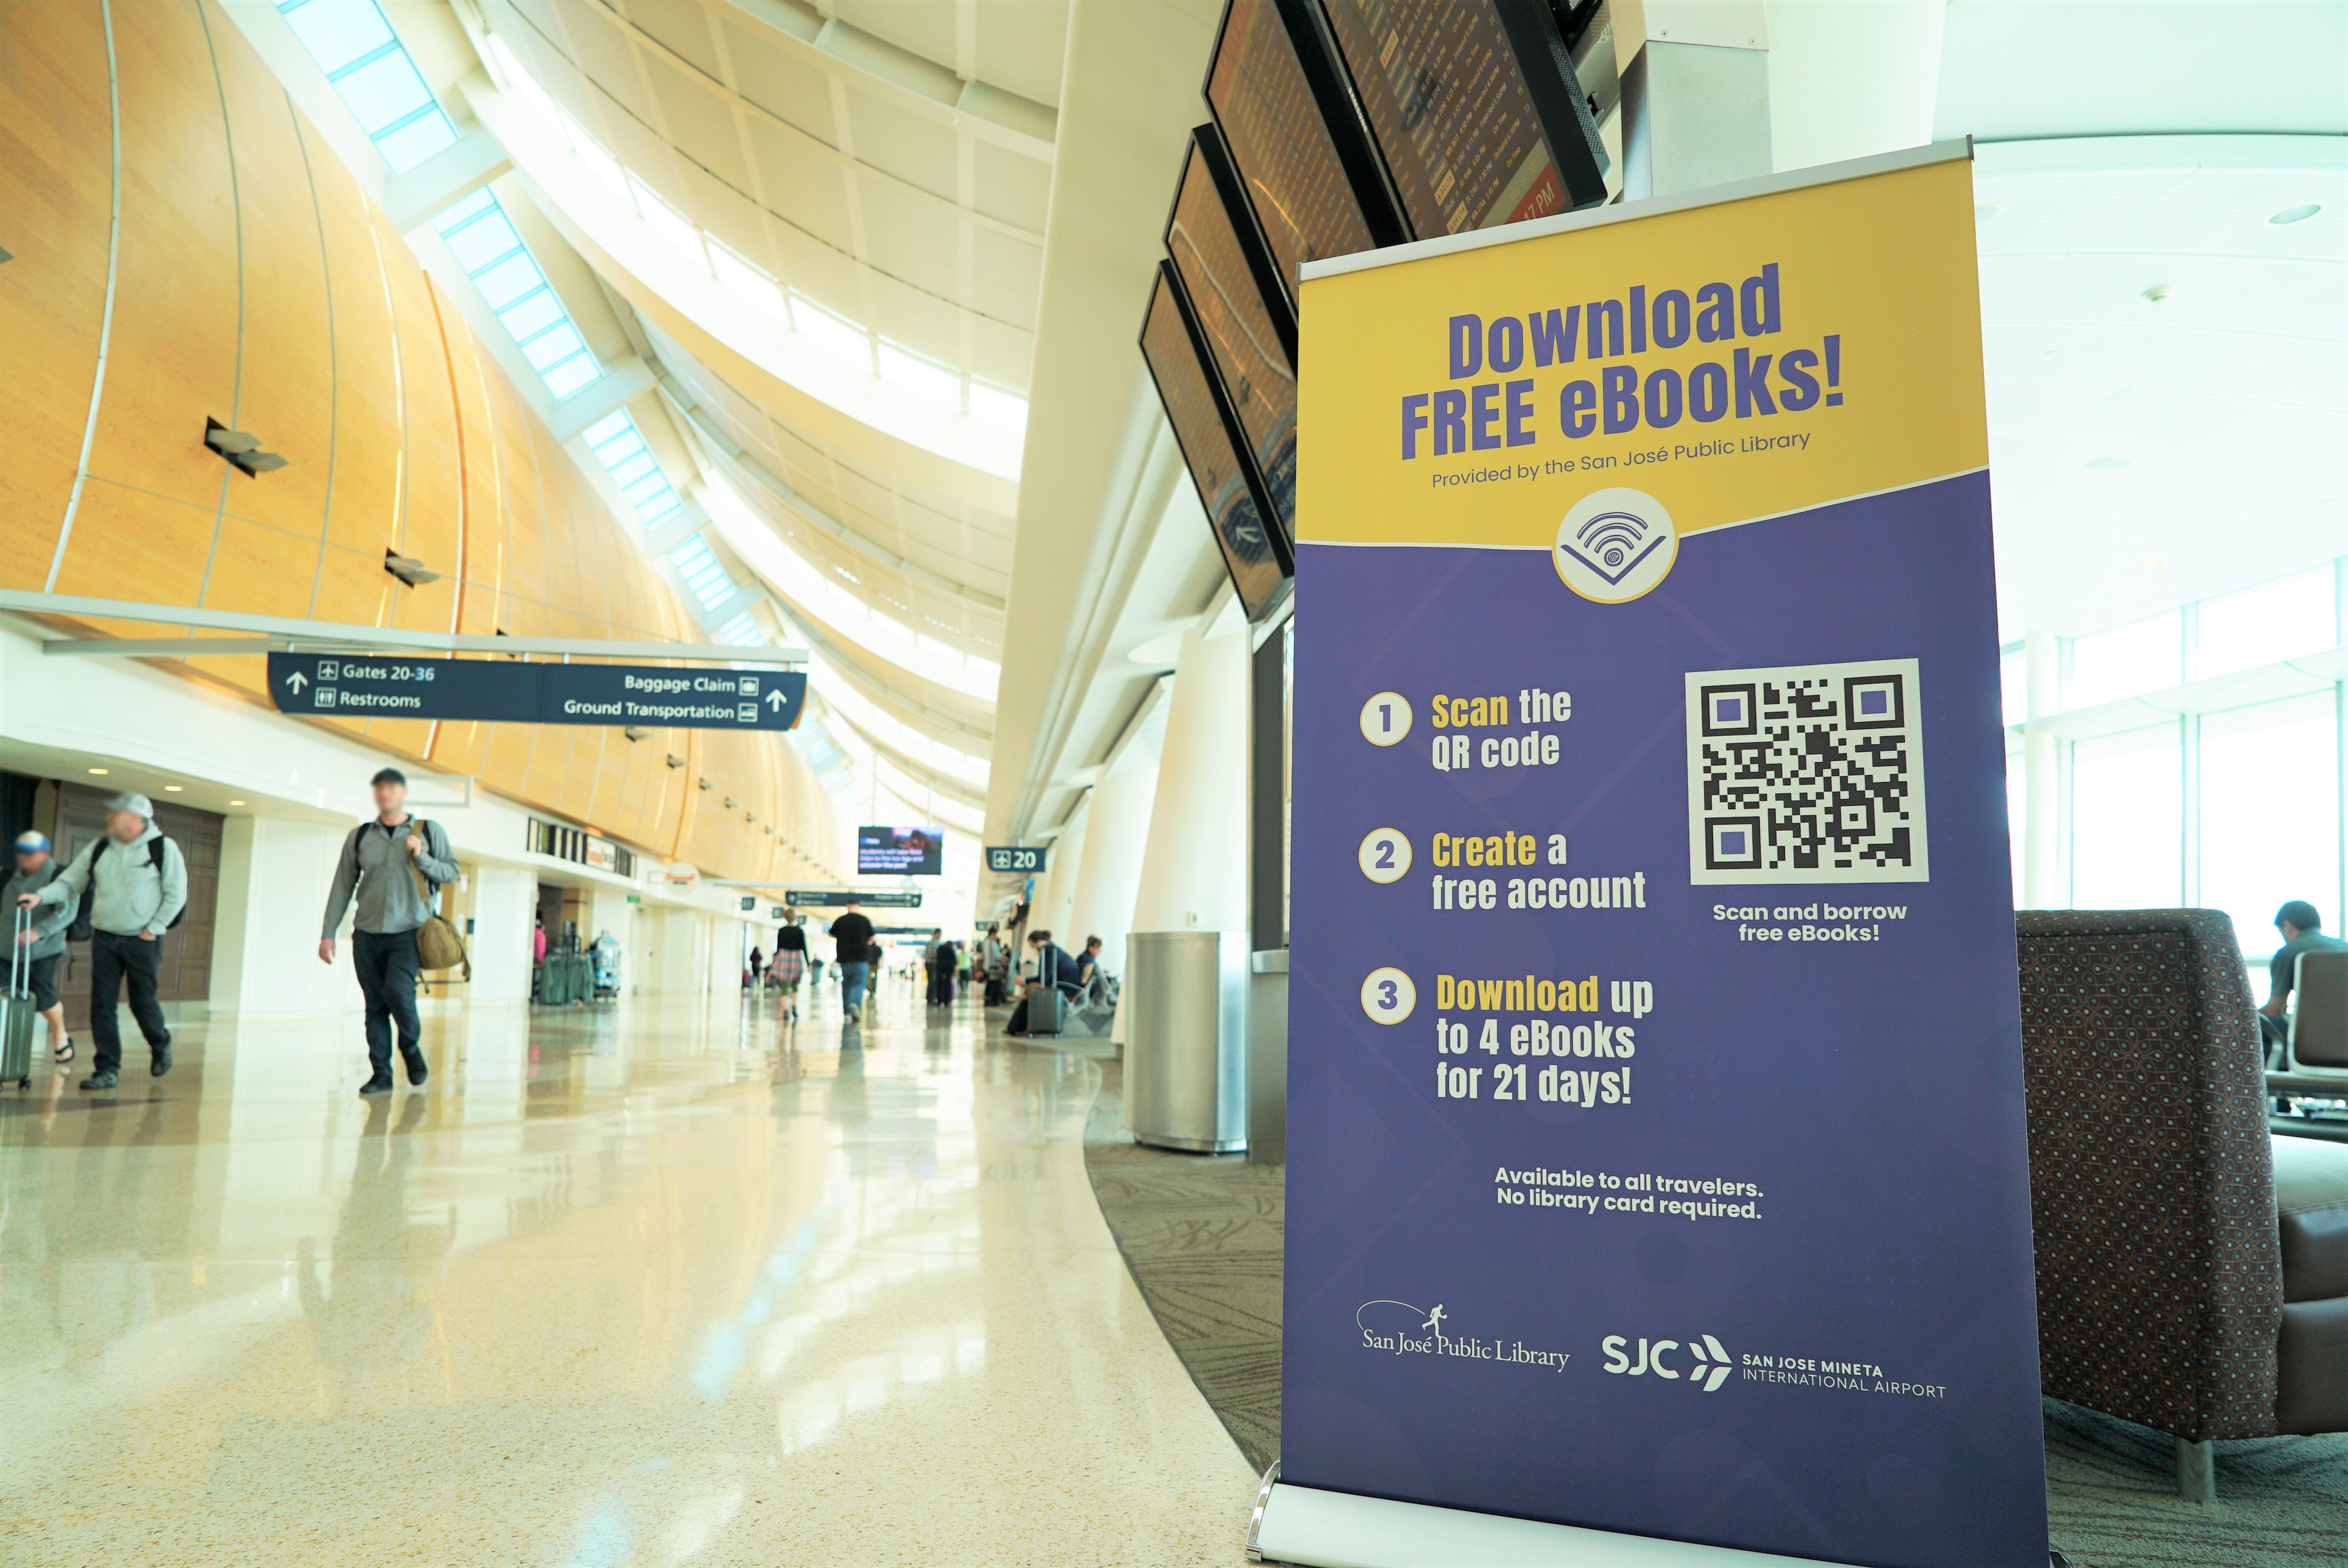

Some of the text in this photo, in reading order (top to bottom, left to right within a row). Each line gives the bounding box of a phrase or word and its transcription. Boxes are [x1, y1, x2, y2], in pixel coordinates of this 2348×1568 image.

[1440, 174, 1452, 196] DELTA
[1536, 182, 1555, 214] PM
[1453, 205, 1465, 226] DELTA
[1449, 262, 1781, 380] Download
[1402, 334, 1844, 460] FREE eBooks!
[1433, 433, 1811, 487] Provided by the San José Public Library
[343, 664, 435, 681] Gates 20-36
[625, 675, 736, 693] Baggage Claim
[340, 691, 421, 708] Restrooms
[564, 699, 735, 720] Ground Transportation
[1432, 688, 1572, 728] Scan the
[1379, 704, 1391, 732] 1
[1432, 731, 1559, 772] QR code
[1013, 851, 1036, 869] 20
[1375, 840, 1394, 868] 2
[1433, 831, 1567, 867] Create a
[1432, 871, 1646, 910] free account
[1713, 903, 1907, 920] Scan and borrow
[1739, 924, 1880, 941] free eBooks!
[1378, 980, 1398, 1009] 3
[1437, 974, 1654, 1018] Download up
[1436, 1018, 1635, 1058] to 4 eBooks
[1436, 1061, 1631, 1107] for 21 days!
[1495, 1167, 1764, 1198] Available to all travelers.
[1497, 1188, 1762, 1221] No library card required.
[1362, 1329, 1571, 1373] San José Public Library
[1602, 1335, 1680, 1379] SJC
[1742, 1354, 1883, 1378] SAN JOSE MINETA
[1743, 1368, 1945, 1399] INTERNATIONAL AIRPORT
